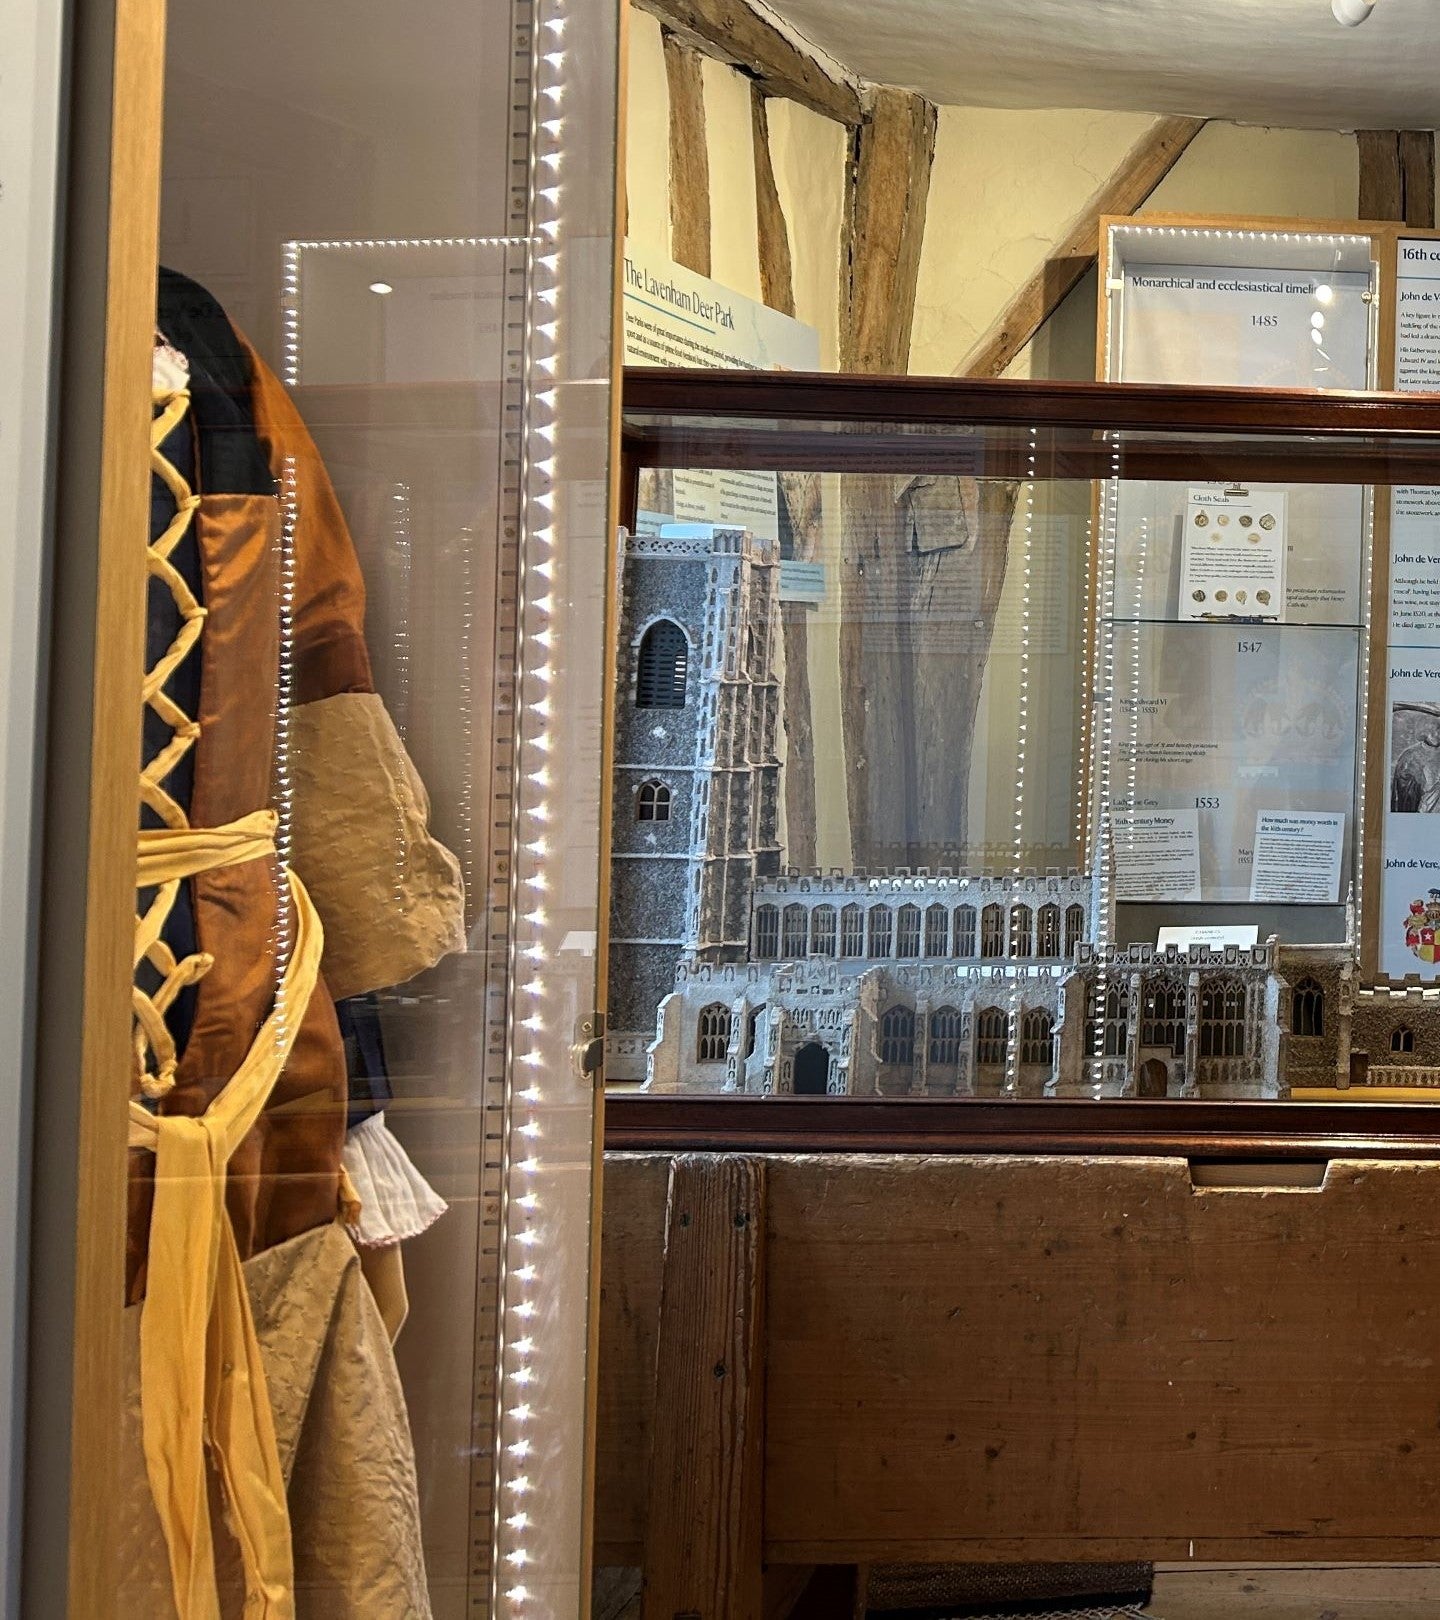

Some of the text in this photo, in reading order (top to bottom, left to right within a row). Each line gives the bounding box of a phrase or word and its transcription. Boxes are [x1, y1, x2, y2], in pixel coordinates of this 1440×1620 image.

[1402, 247, 1427, 260] 16th
[1130, 275, 1195, 289] Monarchical
[1195, 277, 1217, 290] and
[1216, 278, 1284, 293] ecclesiastical
[624, 258, 735, 331] The Lavenham Deer Park
[1399, 291, 1420, 302] John
[1421, 291, 1432, 301] de
[1252, 315, 1278, 327] 1485
[1392, 553, 1414, 567] John
[1414, 554, 1426, 567] de
[1237, 641, 1262, 653] 1547
[1387, 668, 1410, 680] John
[1411, 668, 1422, 678] de
[1195, 797, 1220, 809] 1553
[1382, 857, 1405, 871] John
[1406, 858, 1418, 868] de
[1418, 859, 1440, 870] Vere,
